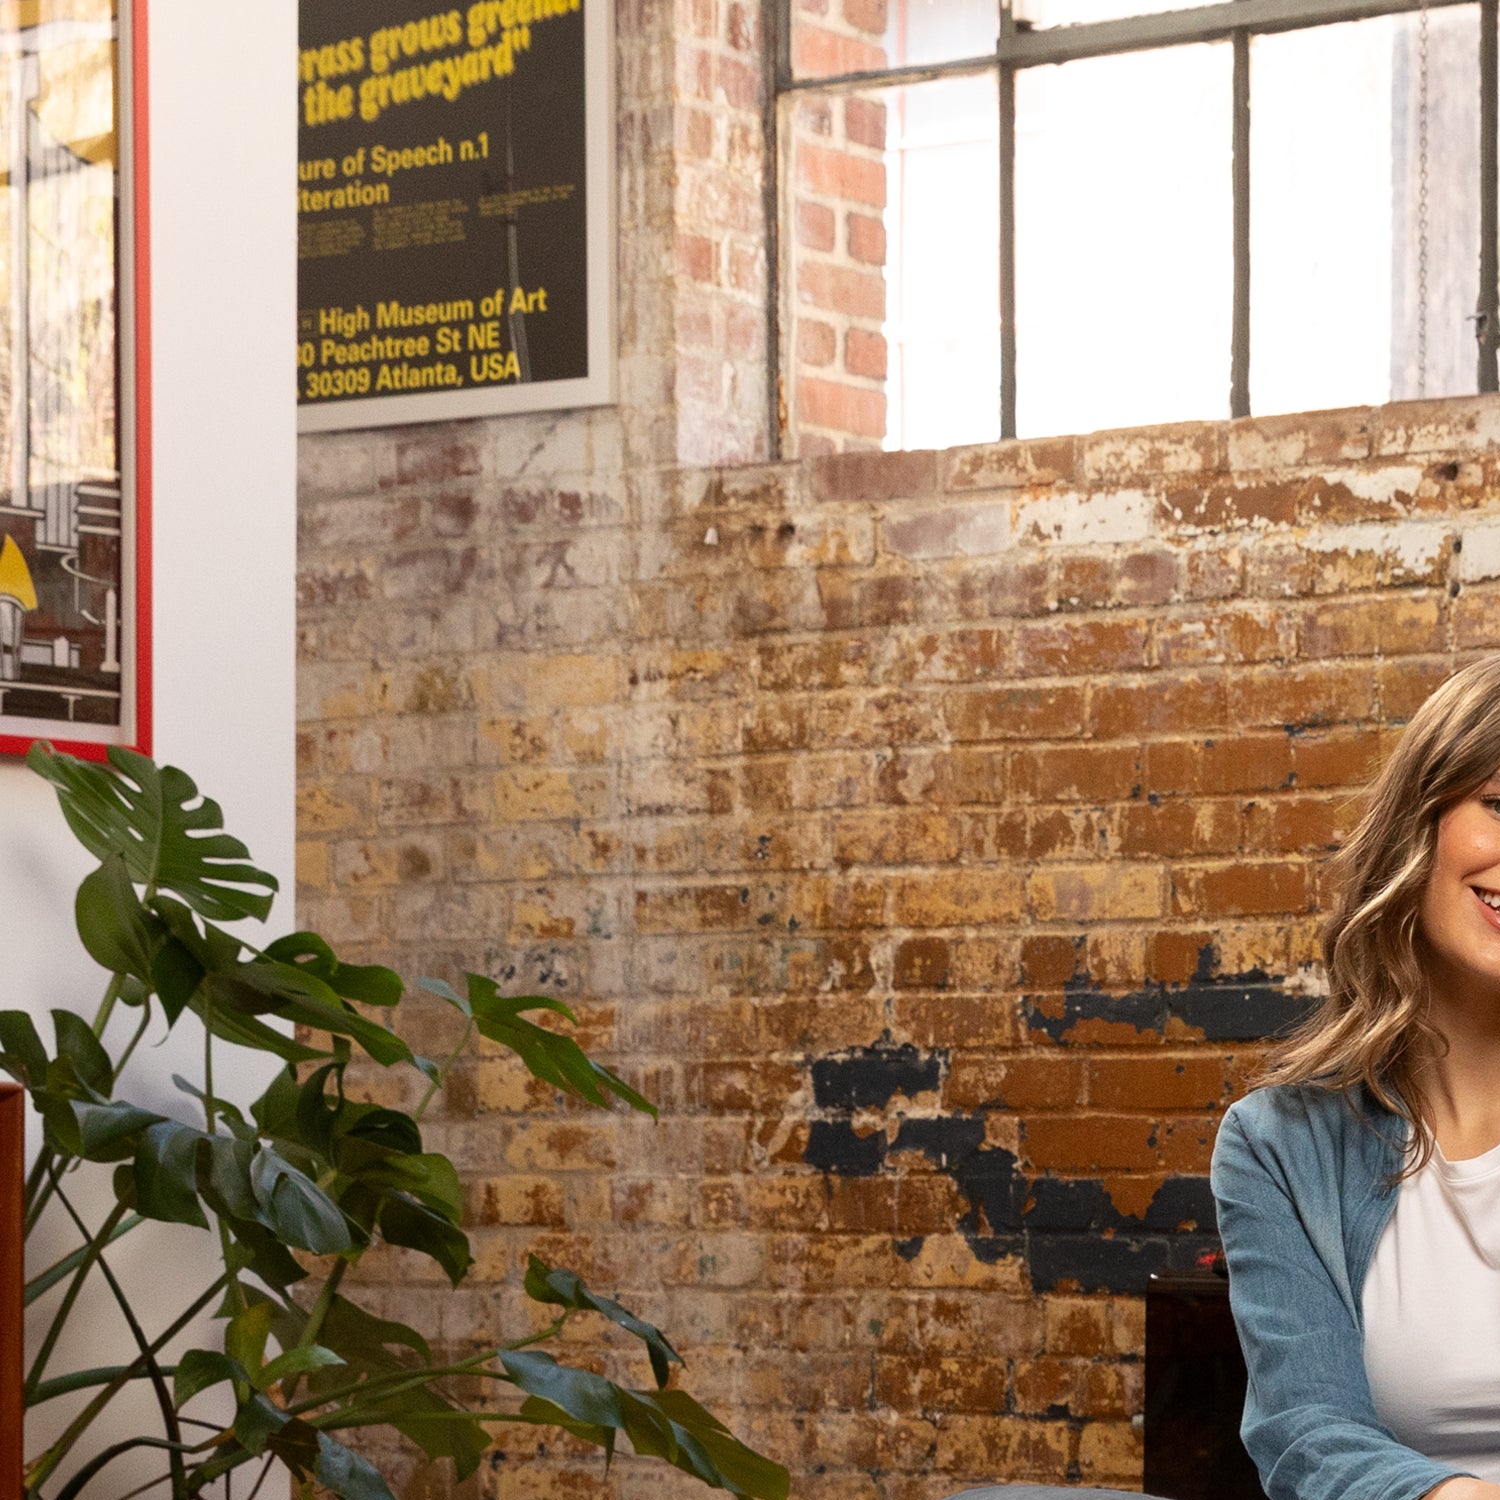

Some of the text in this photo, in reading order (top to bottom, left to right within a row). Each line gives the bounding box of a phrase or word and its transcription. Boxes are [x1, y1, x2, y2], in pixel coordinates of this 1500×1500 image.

[369, 10, 462, 74] grows
[304, 82, 354, 126] the
[342, 147, 366, 176] of
[370, 137, 453, 177] Speech
[459, 131, 488, 161] n.1
[319, 305, 370, 338] High
[376, 299, 474, 329] Museum
[480, 288, 504, 318] of
[508, 287, 547, 315] Art
[320, 334, 430, 365] Peachtree
[436, 326, 462, 354] St
[467, 321, 500, 351] NE
[306, 351, 521, 398] 30309 Atlanta, USA
